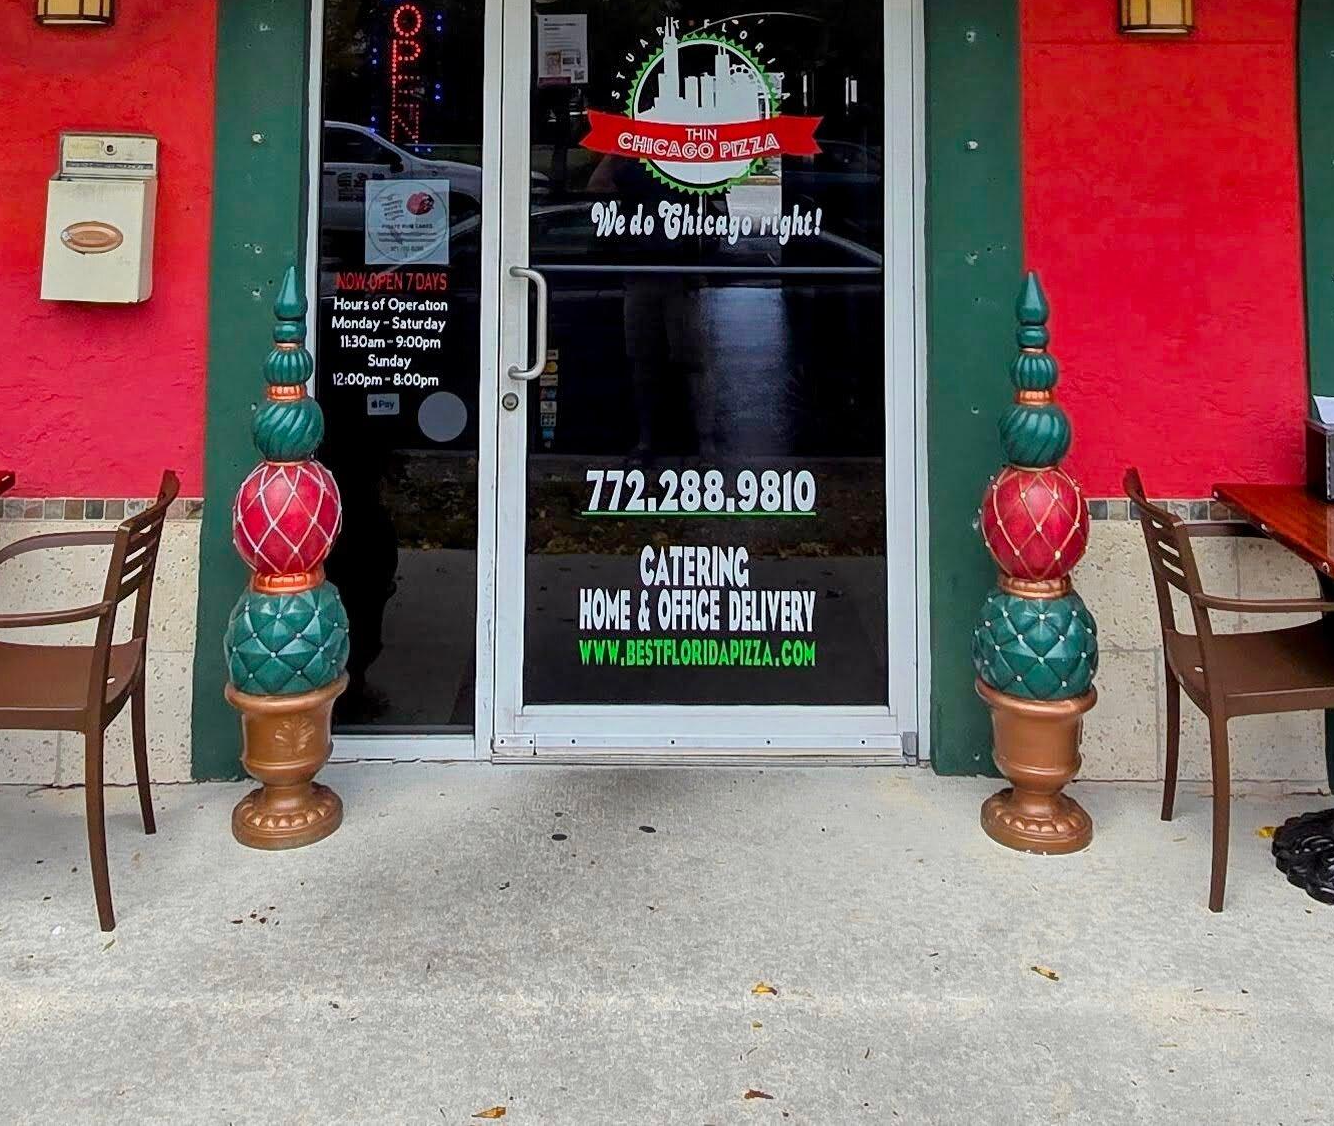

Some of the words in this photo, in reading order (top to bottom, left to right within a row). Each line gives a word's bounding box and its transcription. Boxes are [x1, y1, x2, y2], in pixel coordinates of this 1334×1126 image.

[390, 4, 422, 143] OPEN
[685, 128, 717, 141] THIN
[618, 132, 714, 159] CHICAGO
[720, 133, 780, 158] PIZZA
[591, 200, 626, 237] We
[630, 203, 655, 235] do
[658, 200, 752, 245] Chicago
[760, 204, 823, 245] right!
[336, 272, 366, 291] NOW
[368, 272, 403, 291] OPEN
[406, 272, 414, 291] 7
[415, 272, 447, 291] DAYS
[334, 296, 369, 311] Hours
[372, 297, 386, 311] of
[388, 297, 448, 313] Operation
[331, 315, 380, 332] Monday
[392, 316, 446, 333] Saturday
[340, 334, 385, 348] 11:30am
[395, 335, 441, 351] 9:00pm
[368, 354, 412, 370] Sunday
[333, 372, 382, 388] 12:00pm
[393, 373, 439, 388] 8:00pm
[378, 400, 395, 410] Pay
[586, 470, 816, 512] 772.288.9810
[640, 545, 750, 587] CATERING
[579, 588, 631, 631] HOME
[637, 589, 651, 632] &
[658, 589, 720, 631] OFFICE
[729, 590, 817, 632] DELIVERY
[579, 639, 817, 667] WWW.BESTFLORIDAPIZZA.COM
